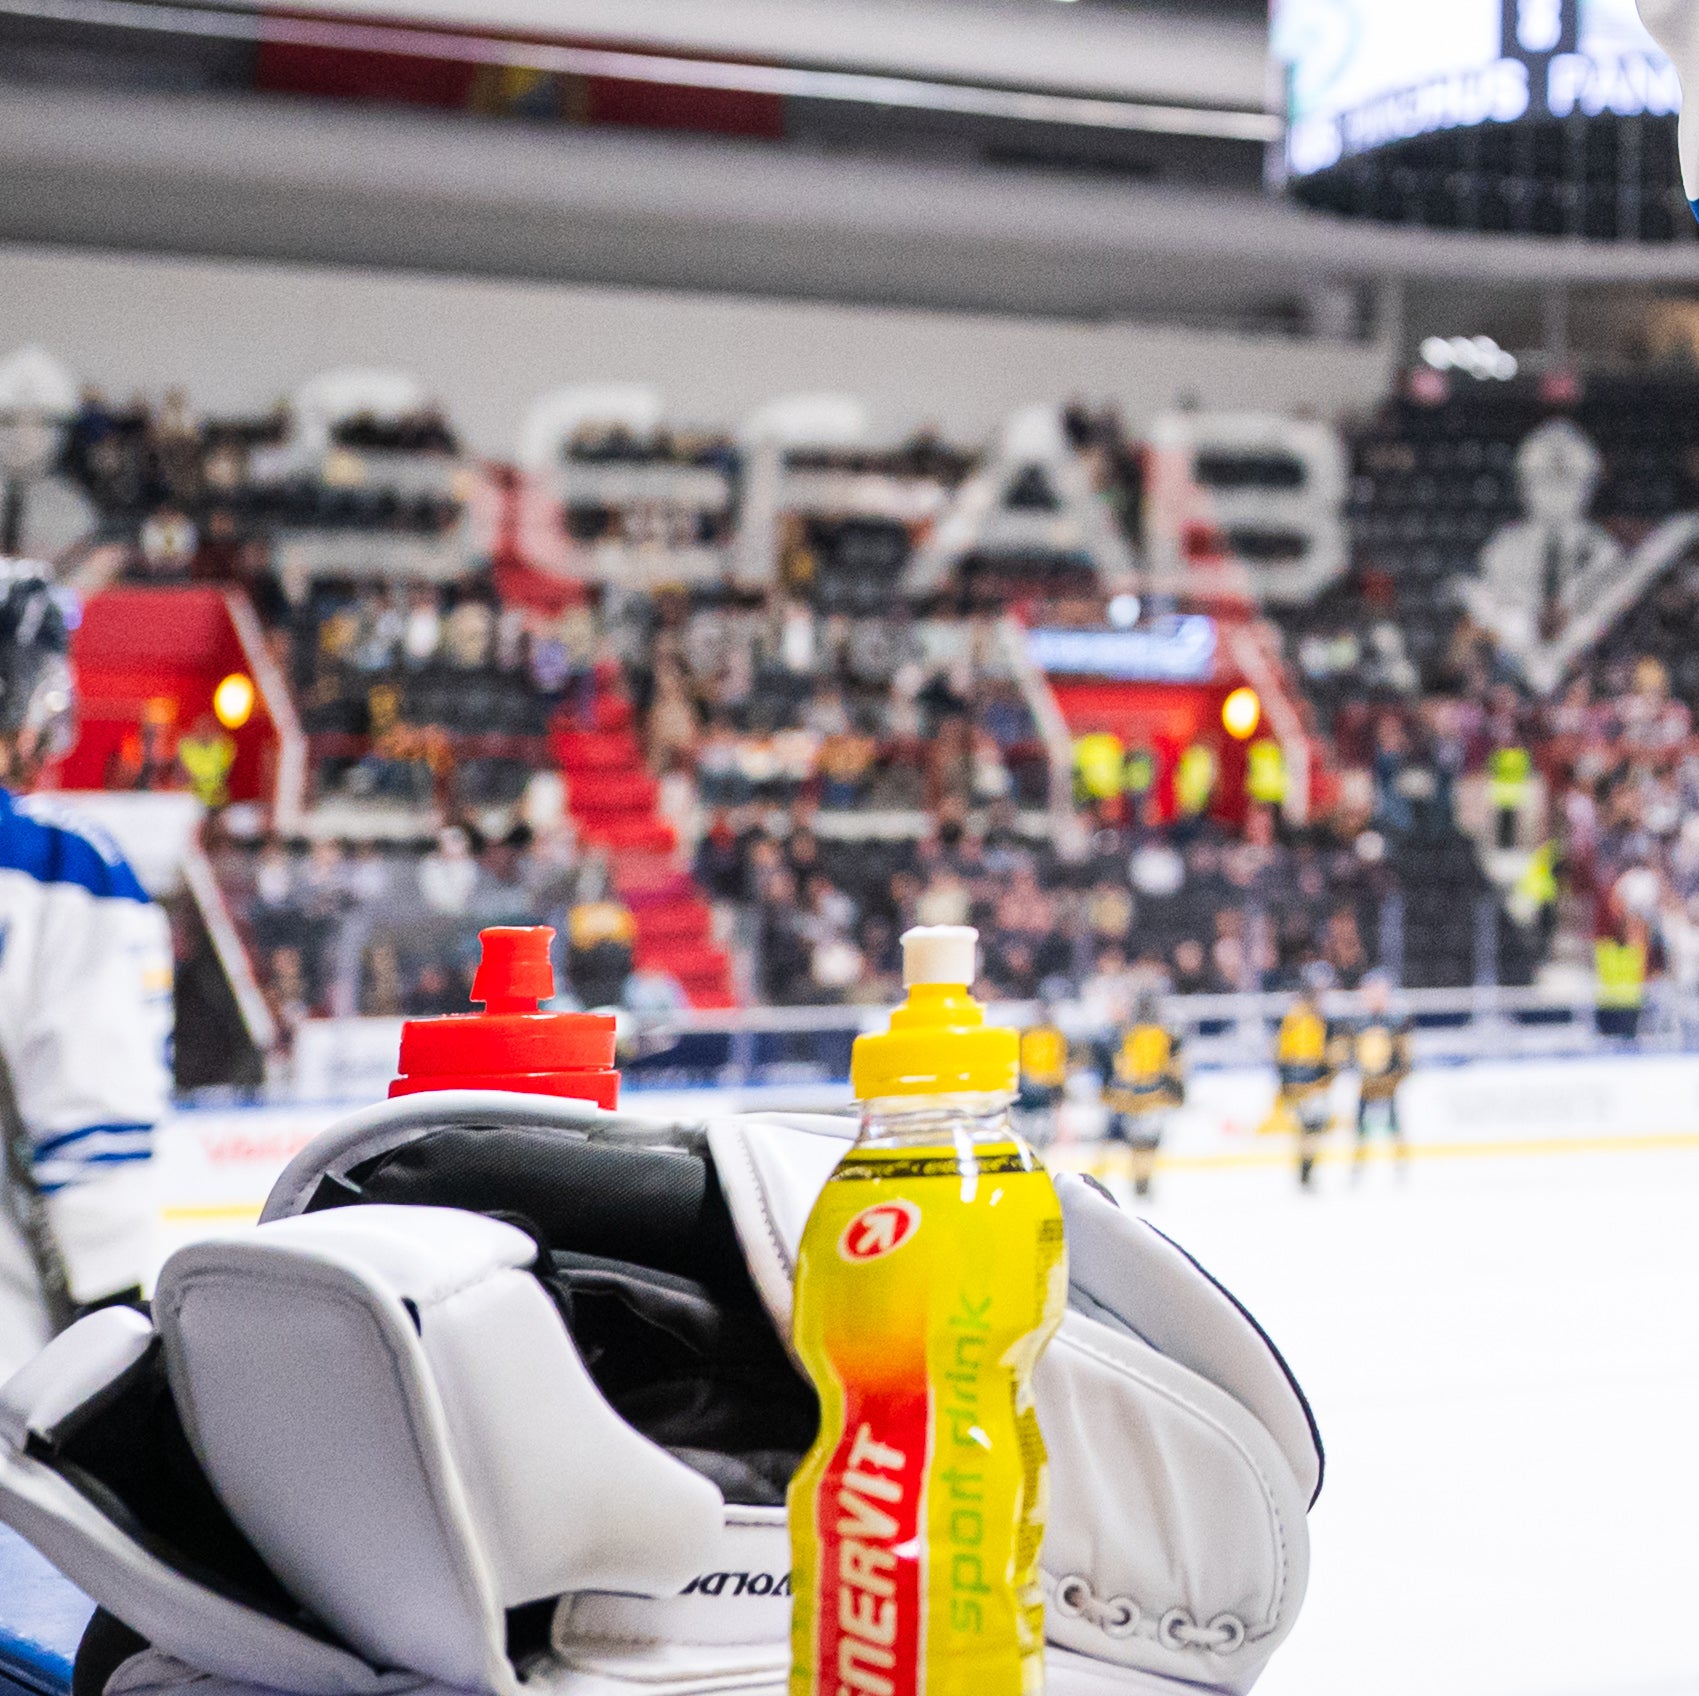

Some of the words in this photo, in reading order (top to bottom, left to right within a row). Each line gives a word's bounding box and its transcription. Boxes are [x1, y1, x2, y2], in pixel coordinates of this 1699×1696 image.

[943, 1292, 994, 1448] drink
[836, 1420, 910, 1696] NERVIT
[941, 1467, 994, 1635] sport
